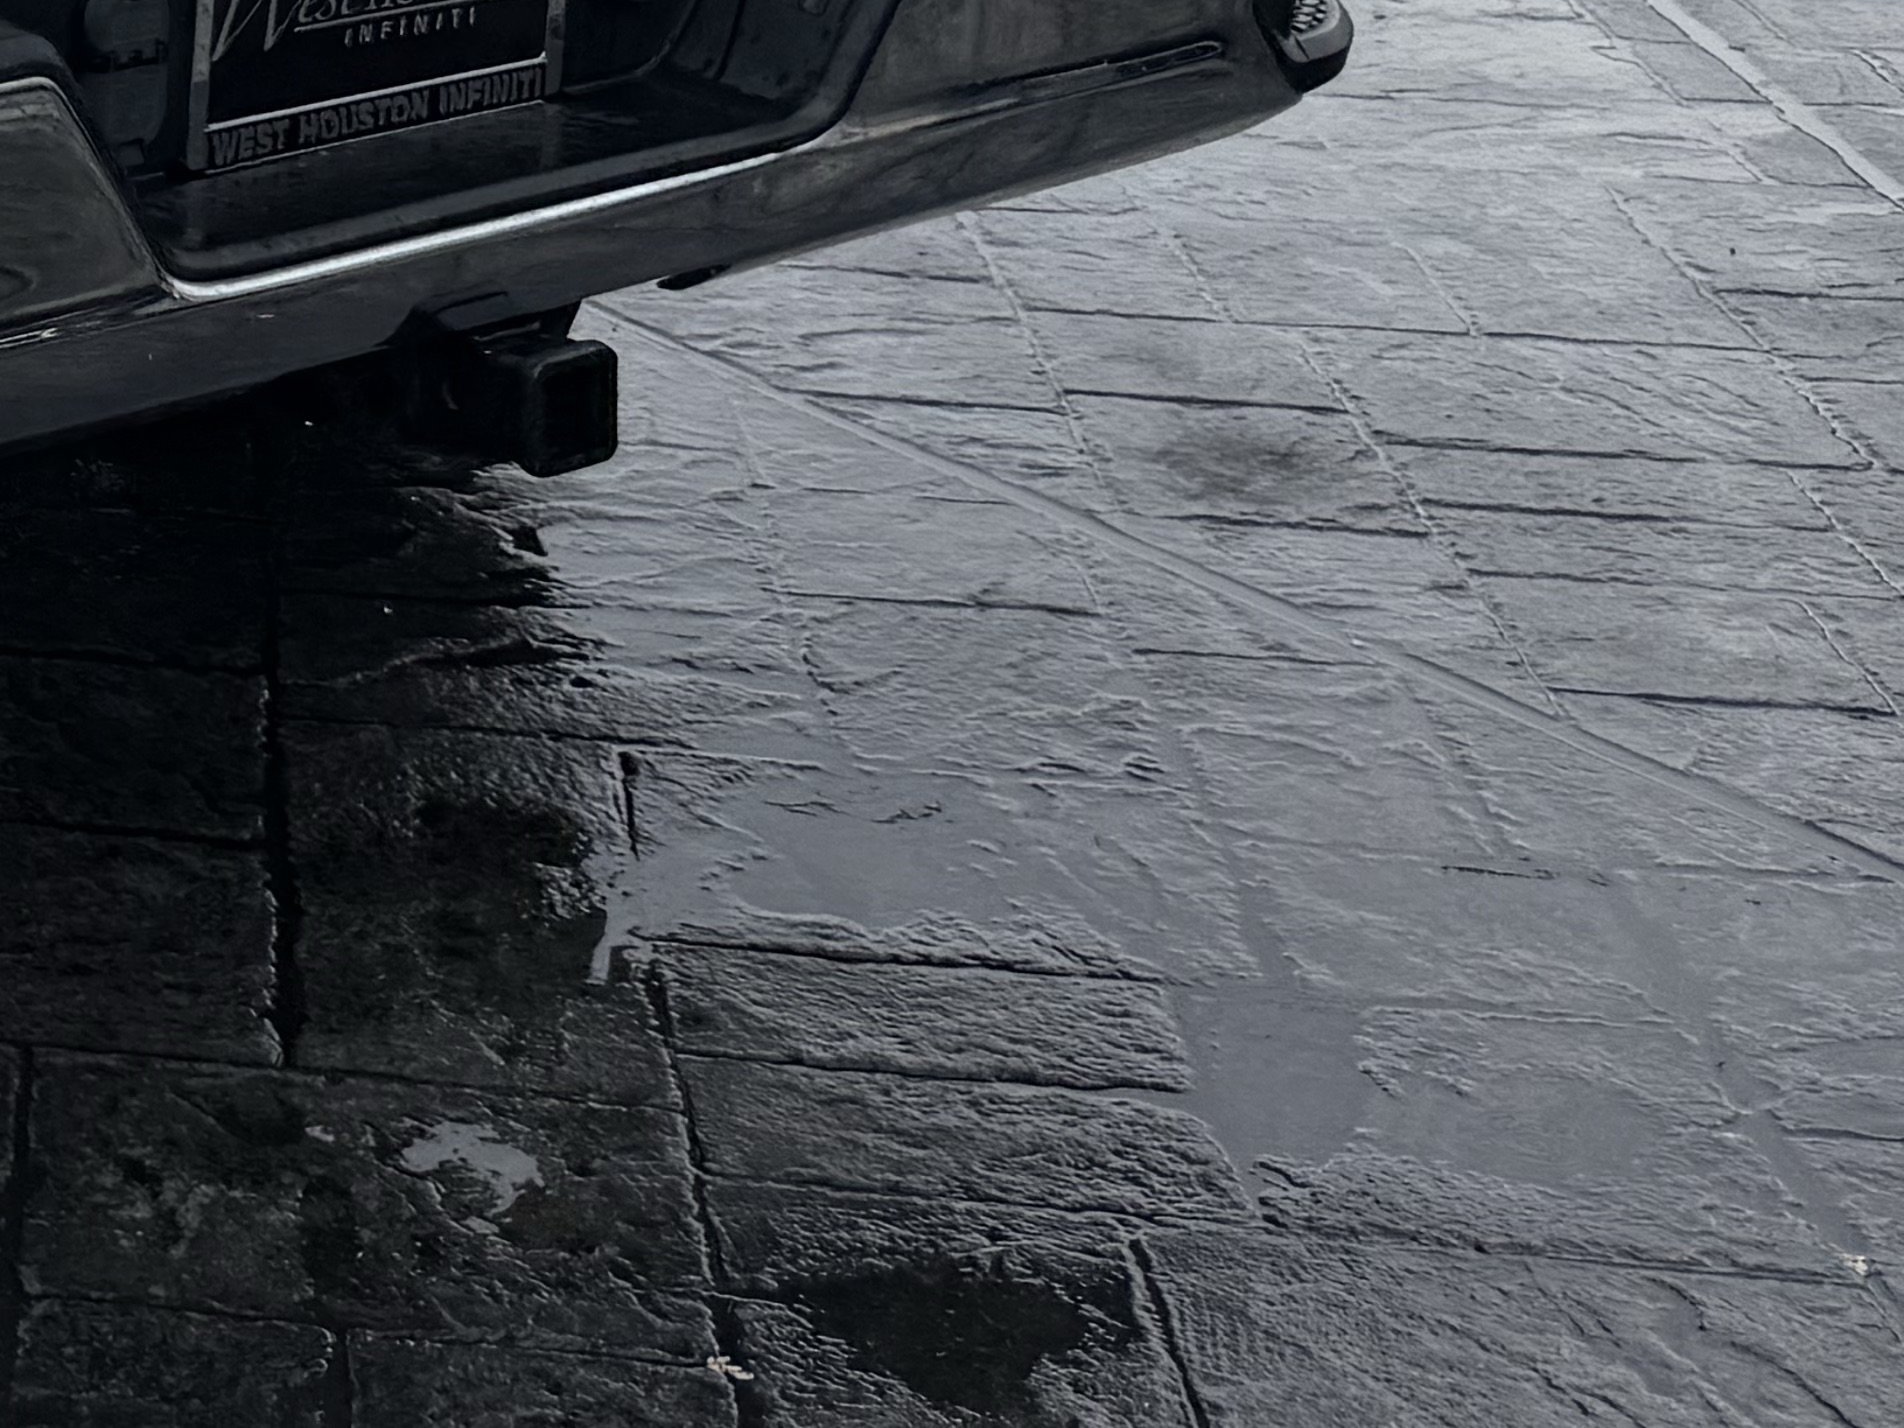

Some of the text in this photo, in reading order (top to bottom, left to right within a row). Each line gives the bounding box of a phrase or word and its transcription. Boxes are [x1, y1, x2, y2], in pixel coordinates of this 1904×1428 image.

[344, 7, 476, 47] INFINITI
[212, 66, 545, 167] WEST HOUSTON INFINITI
